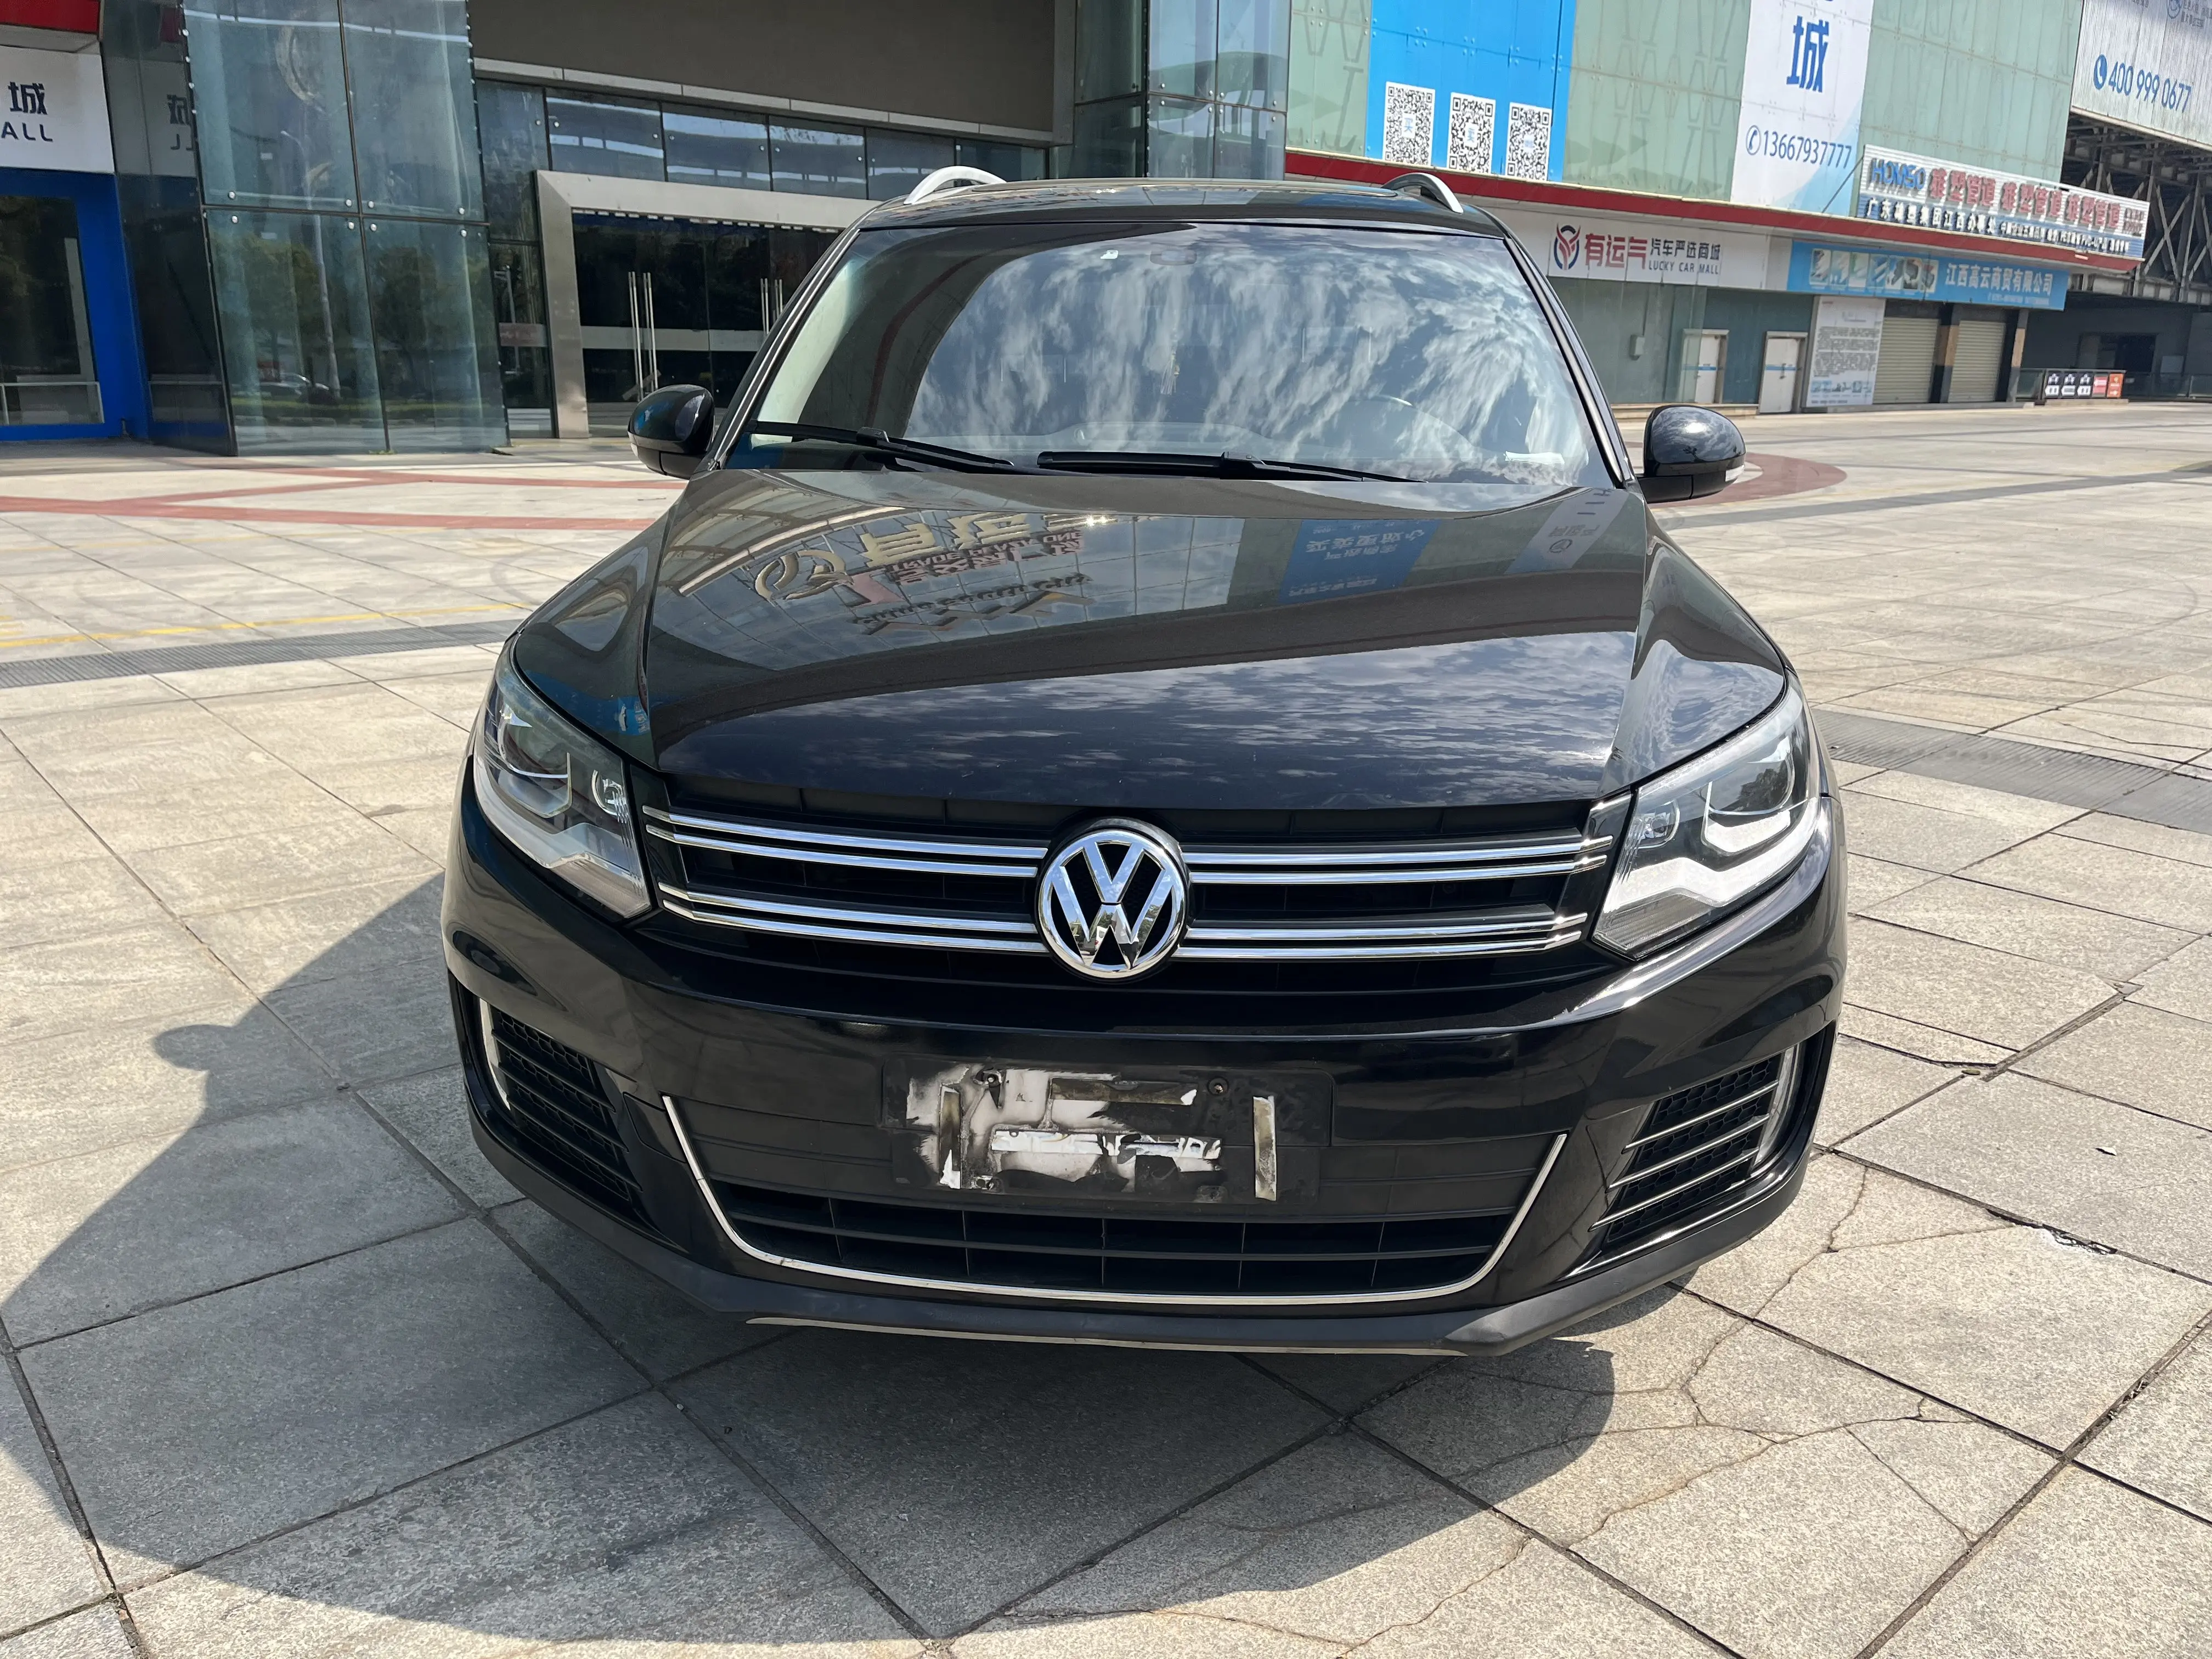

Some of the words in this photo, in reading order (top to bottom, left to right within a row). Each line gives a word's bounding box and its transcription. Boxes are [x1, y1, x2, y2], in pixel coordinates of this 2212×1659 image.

[1786, 15, 1830, 93] 城
[8, 81, 48, 115] 城
[2108, 61, 2134, 96] 400
[2136, 69, 2160, 104] 999
[2162, 78, 2192, 114] 0677
[1, 121, 53, 143] ALL
[1763, 130, 1852, 169] 13667937777
[1584, 232, 1648, 270] 有运气
[1650, 236, 1721, 261] 汽车严选商城
[1648, 259, 1674, 272] LUCKY
[1678, 261, 1695, 273] CAR
[1699, 263, 1720, 275] MALL
[1945, 263, 2053, 295] 江西高云商贸有限公司
